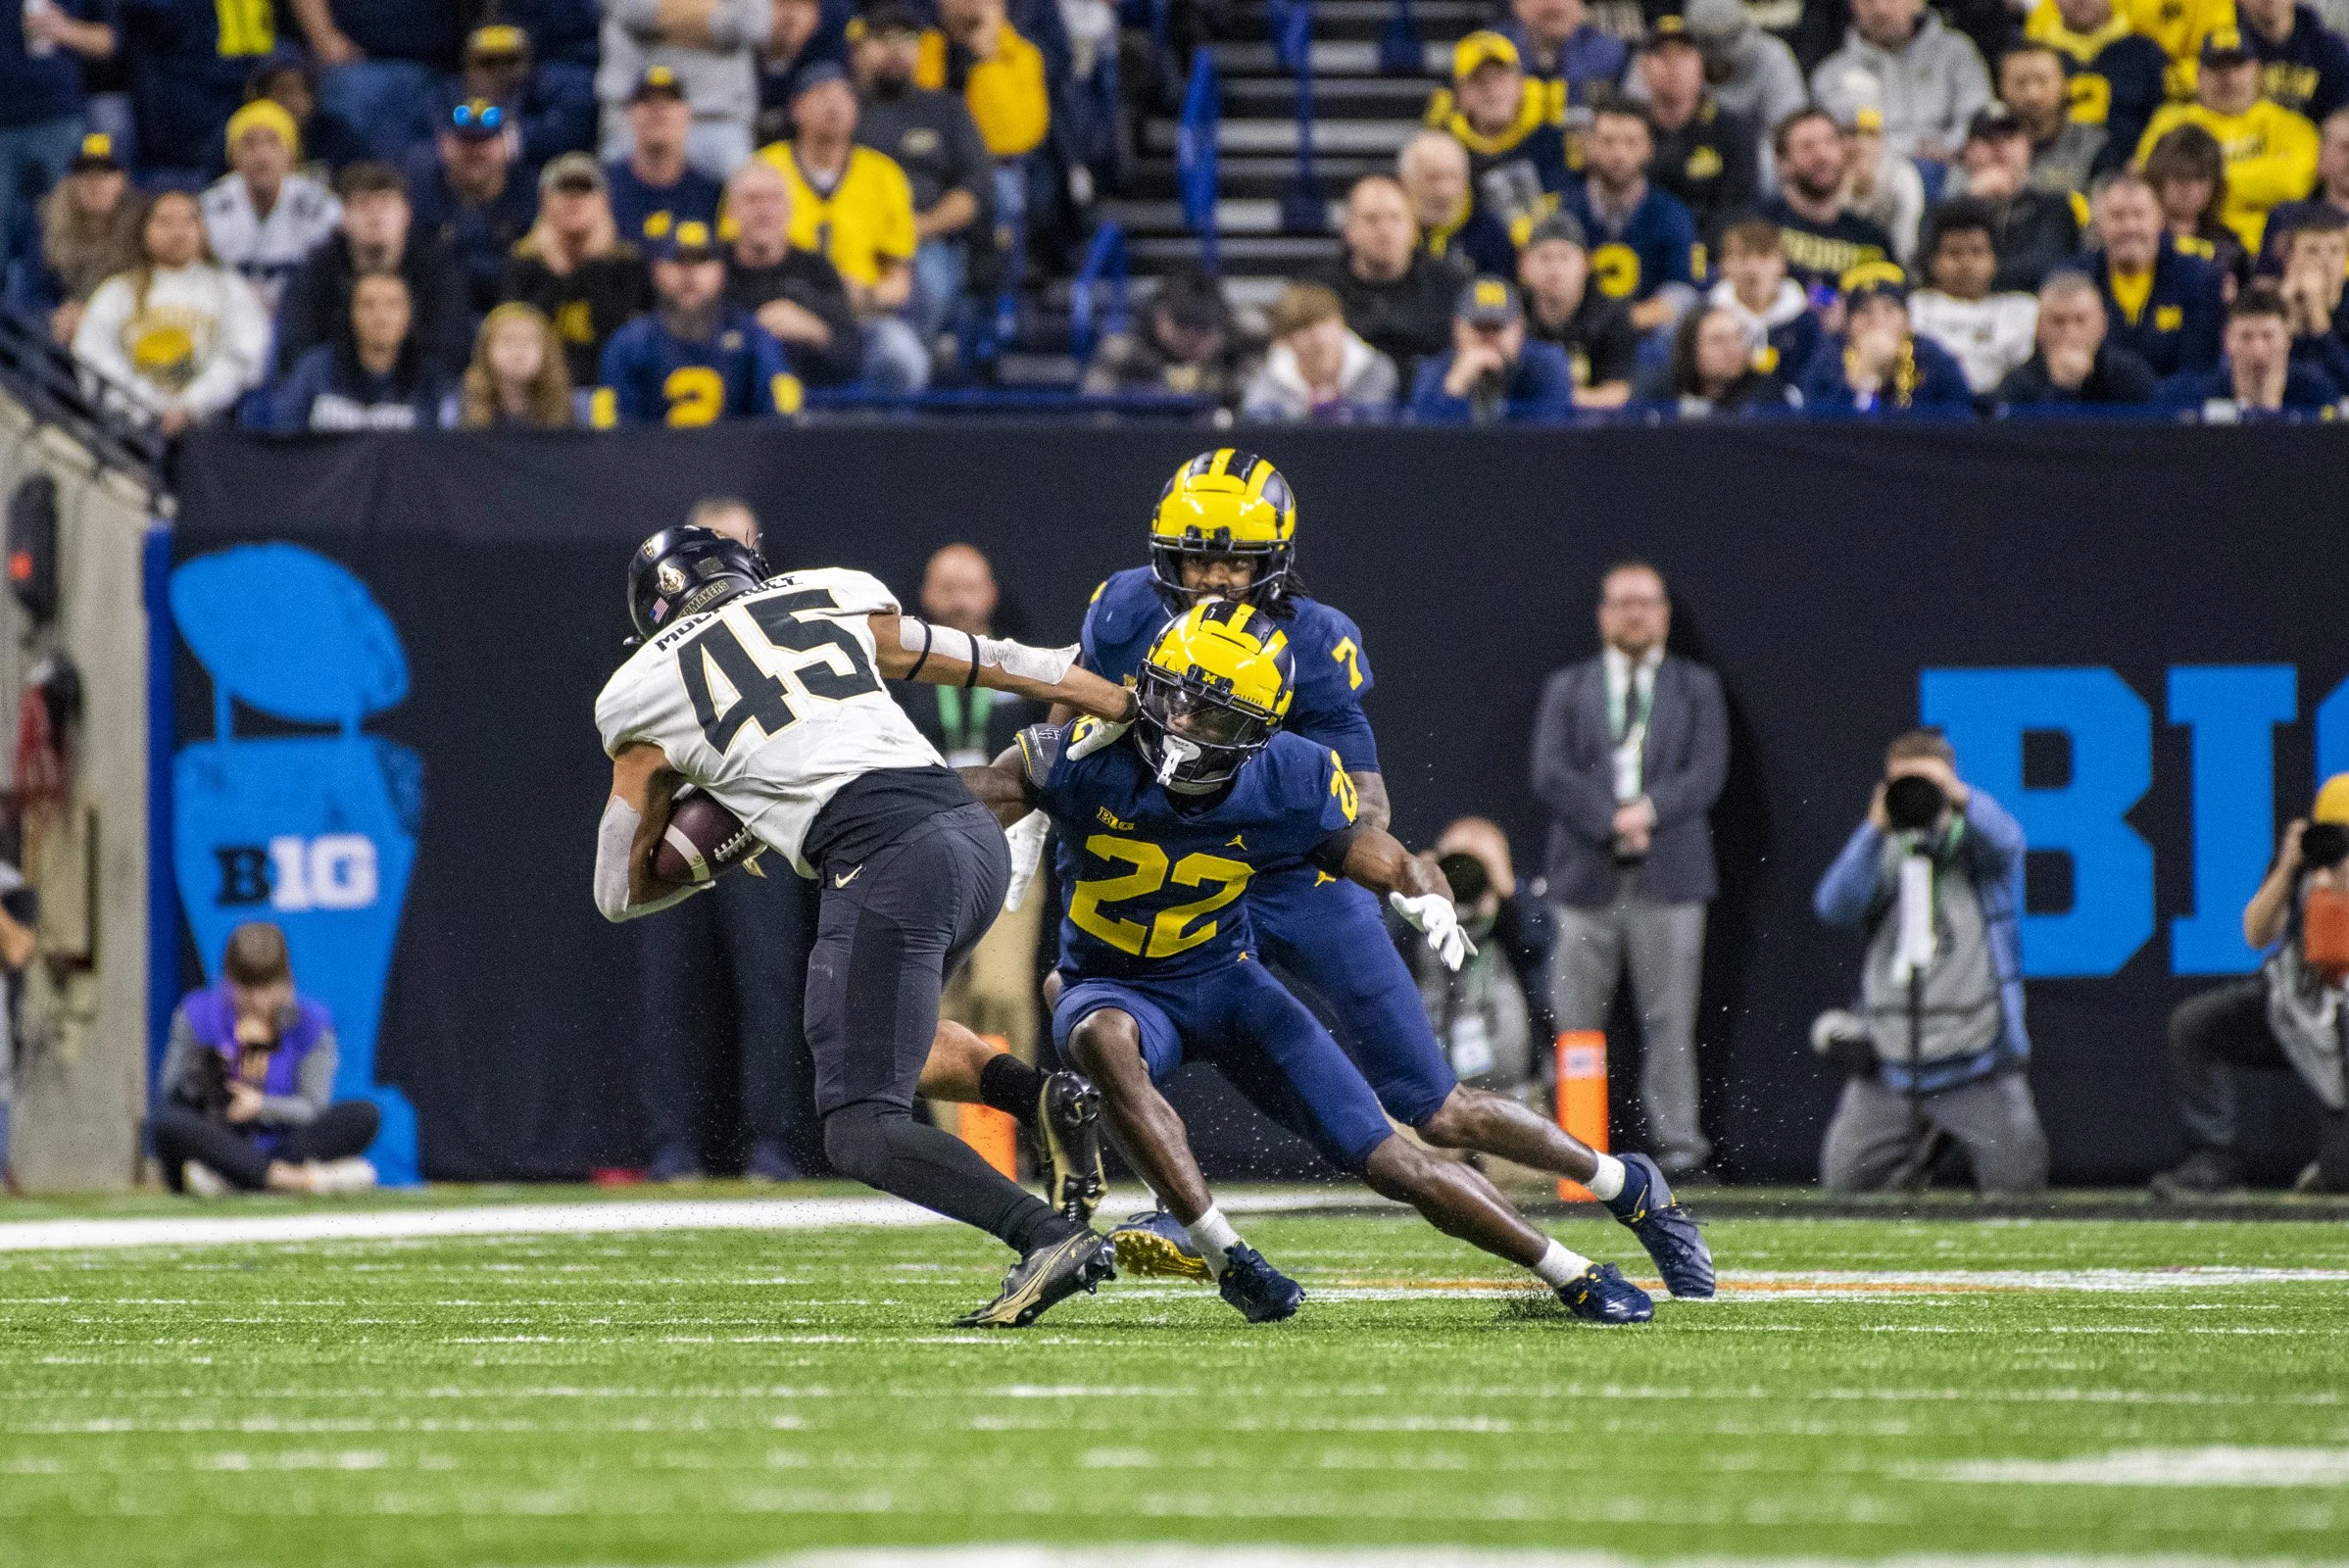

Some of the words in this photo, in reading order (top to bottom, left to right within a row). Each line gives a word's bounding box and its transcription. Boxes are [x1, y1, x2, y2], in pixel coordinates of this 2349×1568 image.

[676, 585, 884, 760] 45
[1202, 671, 1218, 685] M
[1332, 636, 1363, 690] 7
[1920, 665, 2349, 978] BI
[1068, 834, 1256, 957] 22
